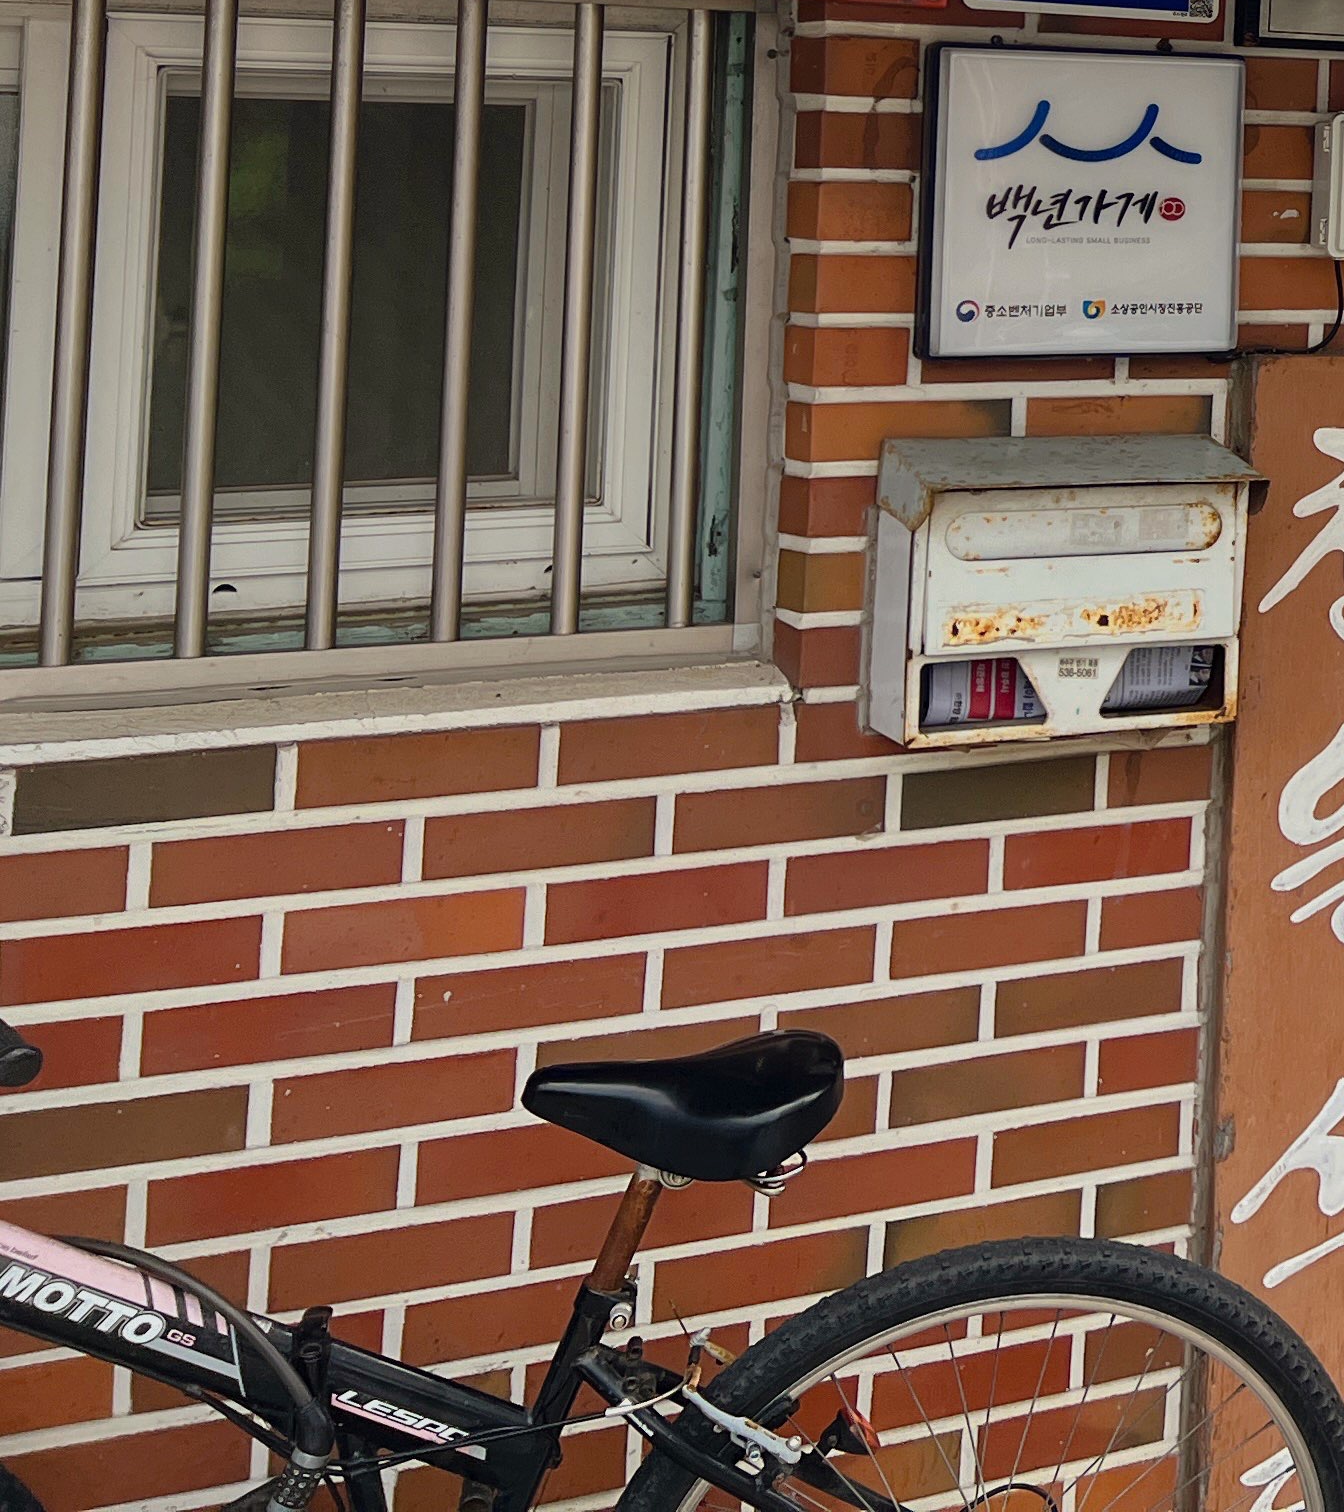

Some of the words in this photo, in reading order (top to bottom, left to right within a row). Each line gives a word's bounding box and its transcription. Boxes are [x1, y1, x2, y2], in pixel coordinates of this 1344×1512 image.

[985, 183, 1160, 250] 백년가게
[984, 303, 1068, 318] 중소벤처기업부
[0, 1263, 164, 1345] MOTTO
[166, 1328, 197, 1347] GS
